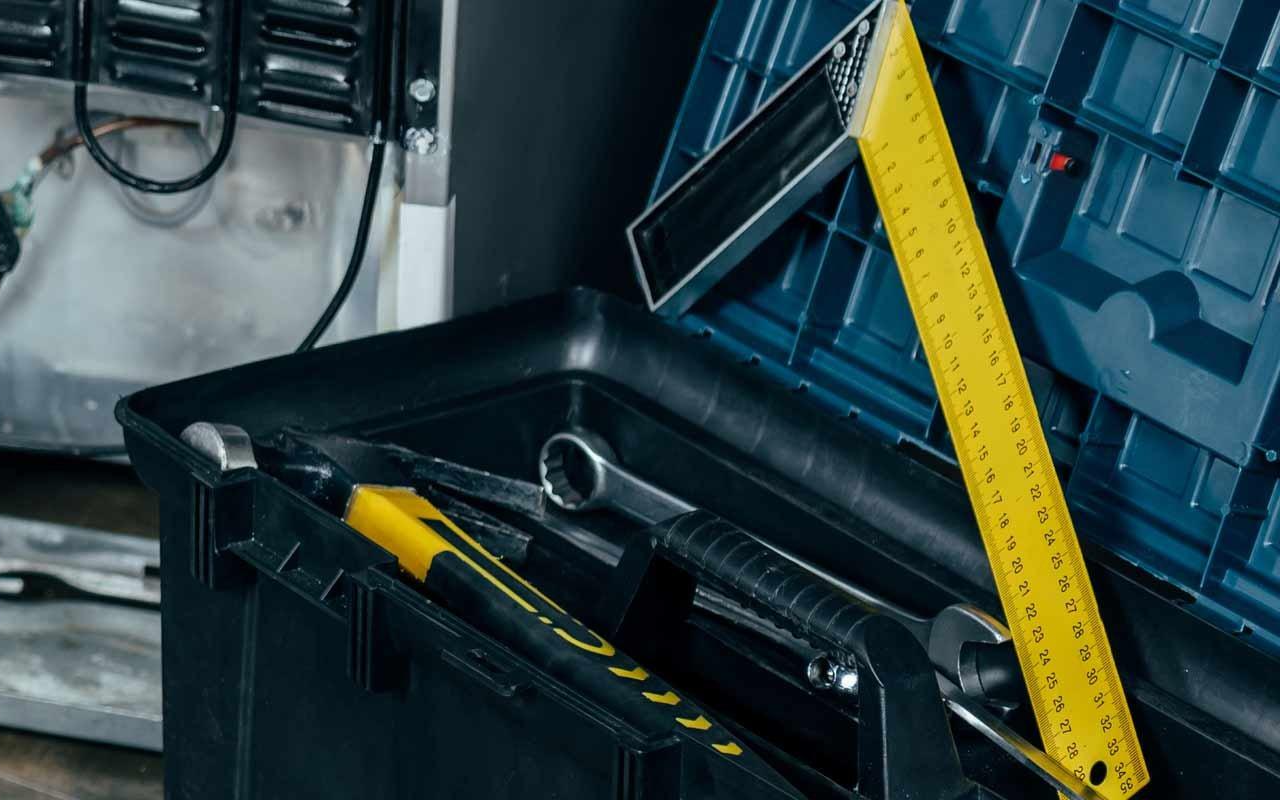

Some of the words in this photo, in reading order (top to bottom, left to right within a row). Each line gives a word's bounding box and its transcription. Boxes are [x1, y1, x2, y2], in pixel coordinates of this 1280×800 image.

[888, 162, 896, 172] 2
[894, 184, 902, 194] 3
[902, 207, 910, 215] 4
[908, 226, 918, 236] 5
[916, 248, 924, 258] 6
[930, 292, 938, 302] 8
[936, 314, 946, 324] 9
[944, 334, 952, 350] 10
[950, 356, 960, 372] 11
[957, 378, 968, 394] 12
[964, 400, 974, 416] 13
[970, 422, 980, 438] 14
[978, 445, 988, 461] 15
[985, 468, 995, 484] 16
[992, 490, 1002, 504] 17
[999, 513, 1009, 528] 18
[1006, 536, 1016, 551] 19
[1012, 557, 1023, 574] 20
[1019, 580, 1030, 596] 21
[1026, 603, 1038, 620] 22
[1032, 626, 1044, 643] 23
[1040, 649, 1050, 666] 24
[1046, 672, 1058, 690] 25
[1054, 696, 1064, 712] 26
[1060, 719, 1072, 734] 27
[1067, 742, 1078, 760] 28
[1074, 766, 1086, 782] 29
[912, 112, 920, 122] 5
[918, 134, 927, 144] 6
[932, 177, 941, 187] 8
[940, 198, 948, 208] 9
[946, 218, 956, 234] 10
[954, 240, 963, 256] 11
[960, 262, 970, 278] 12
[968, 284, 978, 300] 13
[974, 306, 984, 321] 14
[982, 328, 992, 344] 15
[988, 350, 999, 366] 16
[996, 373, 1006, 386] 17
[1003, 395, 1014, 411] 18
[1010, 418, 1020, 433] 19
[1016, 439, 1028, 456] 20
[1024, 462, 1034, 479] 21
[1030, 484, 1042, 501] 22
[1038, 507, 1048, 524] 23
[1044, 529, 1056, 546] 24
[1052, 552, 1063, 570] 25
[1058, 576, 1070, 592] 26
[1065, 598, 1077, 614] 27
[1072, 622, 1084, 639] 28
[1080, 644, 1091, 662] 29
[1086, 668, 1098, 685] 30
[1094, 692, 1104, 709] 31
[1100, 715, 1112, 733] 32
[1108, 738, 1119, 756] 33
[1114, 762, 1126, 780] 34
[1120, 777, 1134, 794] 35
